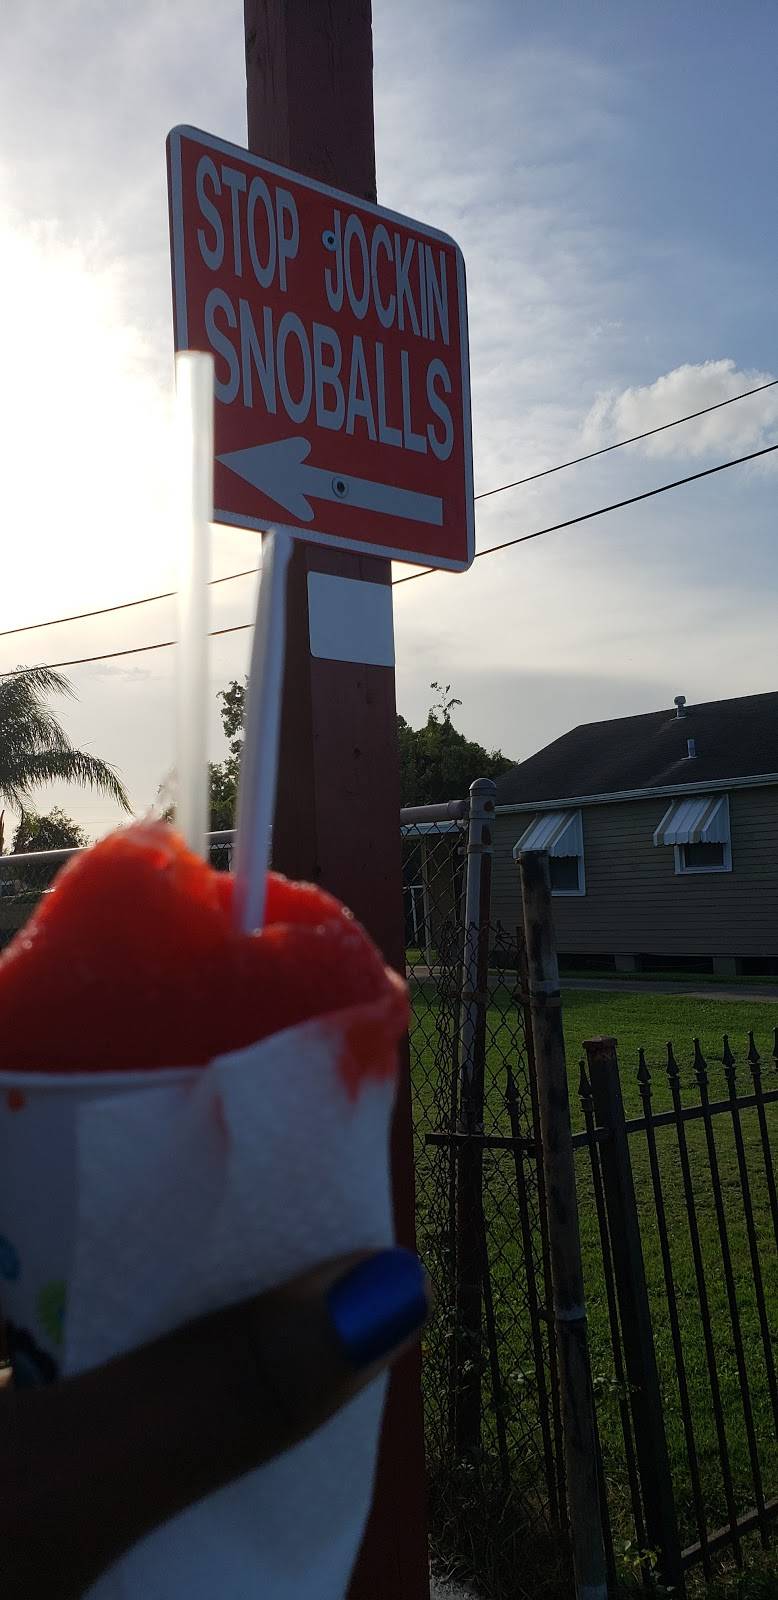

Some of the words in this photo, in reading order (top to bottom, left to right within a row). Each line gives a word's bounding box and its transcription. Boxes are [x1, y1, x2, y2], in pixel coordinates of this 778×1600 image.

[197, 155, 299, 292] STOP
[324, 209, 449, 345] JOCKIN
[205, 288, 454, 461] SNOBALLS
